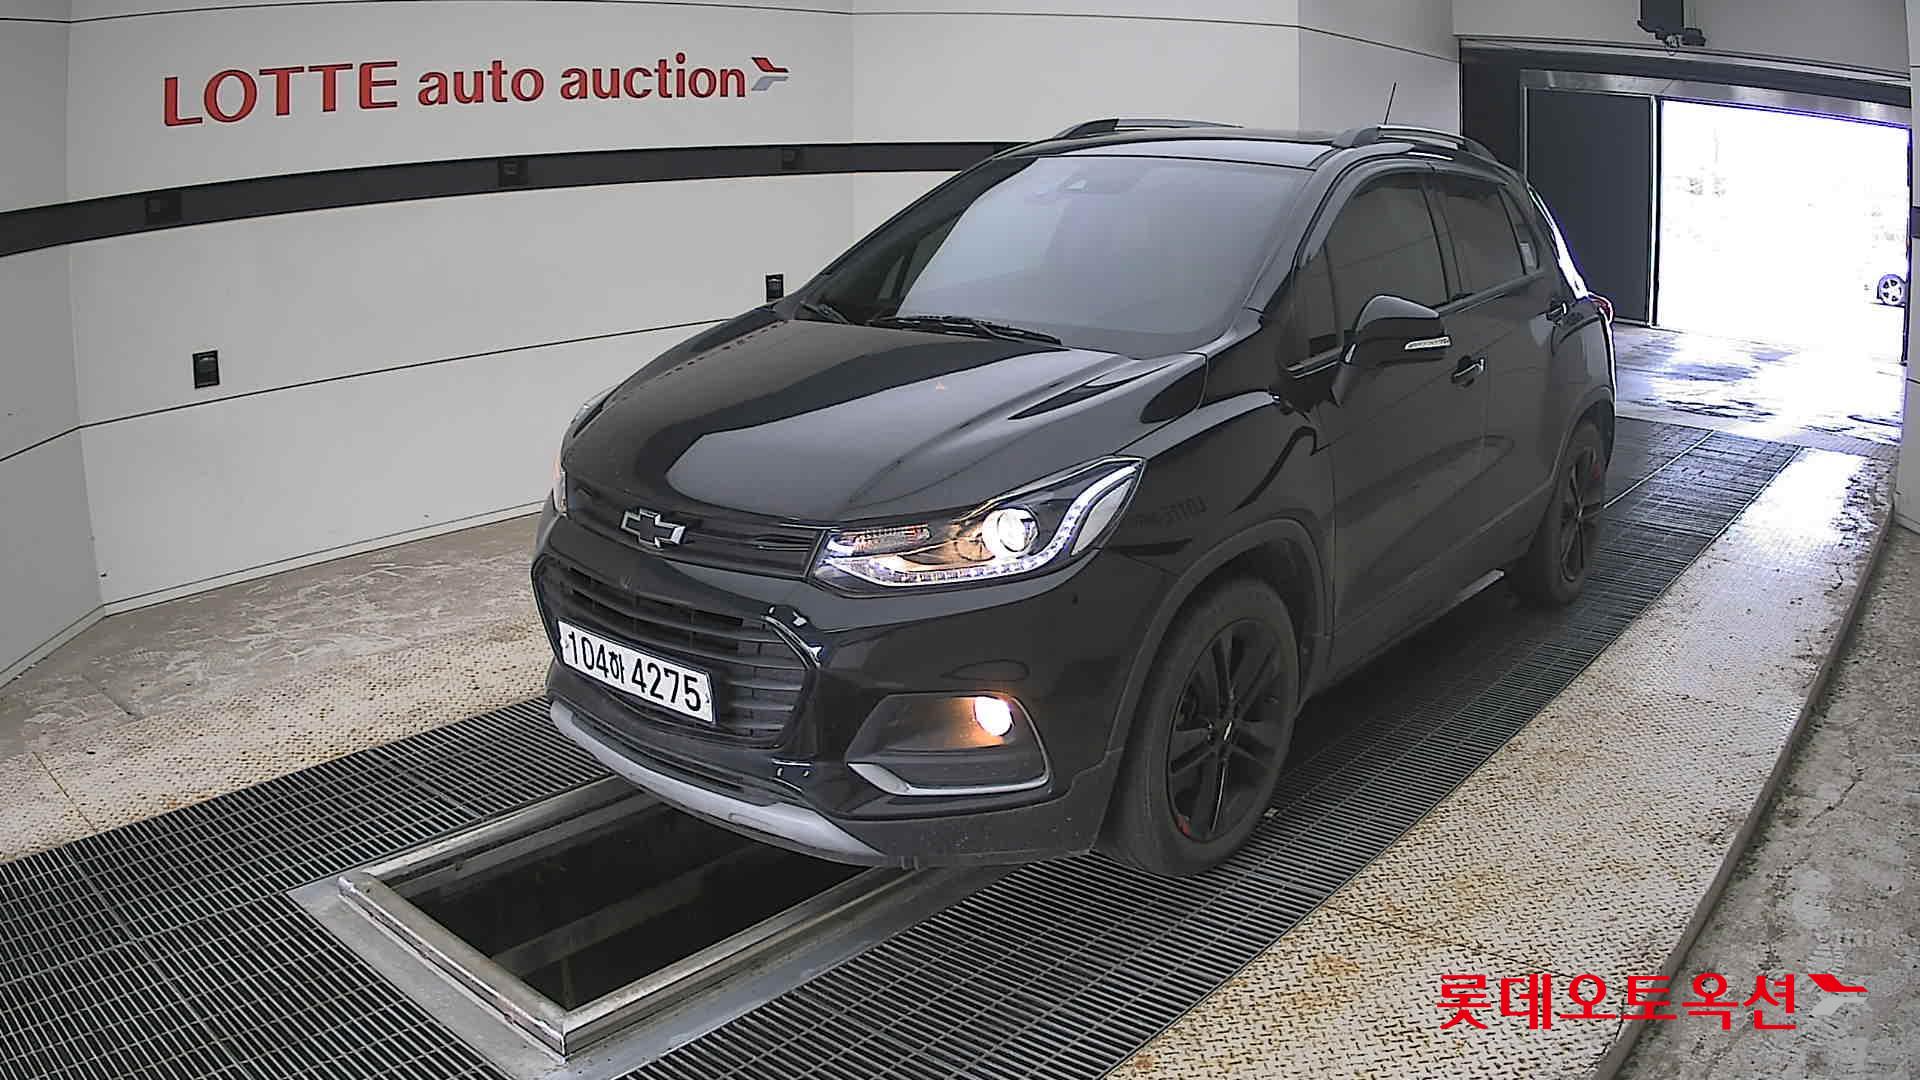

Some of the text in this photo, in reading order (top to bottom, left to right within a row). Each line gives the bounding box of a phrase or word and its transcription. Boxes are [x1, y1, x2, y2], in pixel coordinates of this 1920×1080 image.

[163, 52, 747, 127] LOTTE auto auction
[568, 631, 702, 712] 104하 4275
